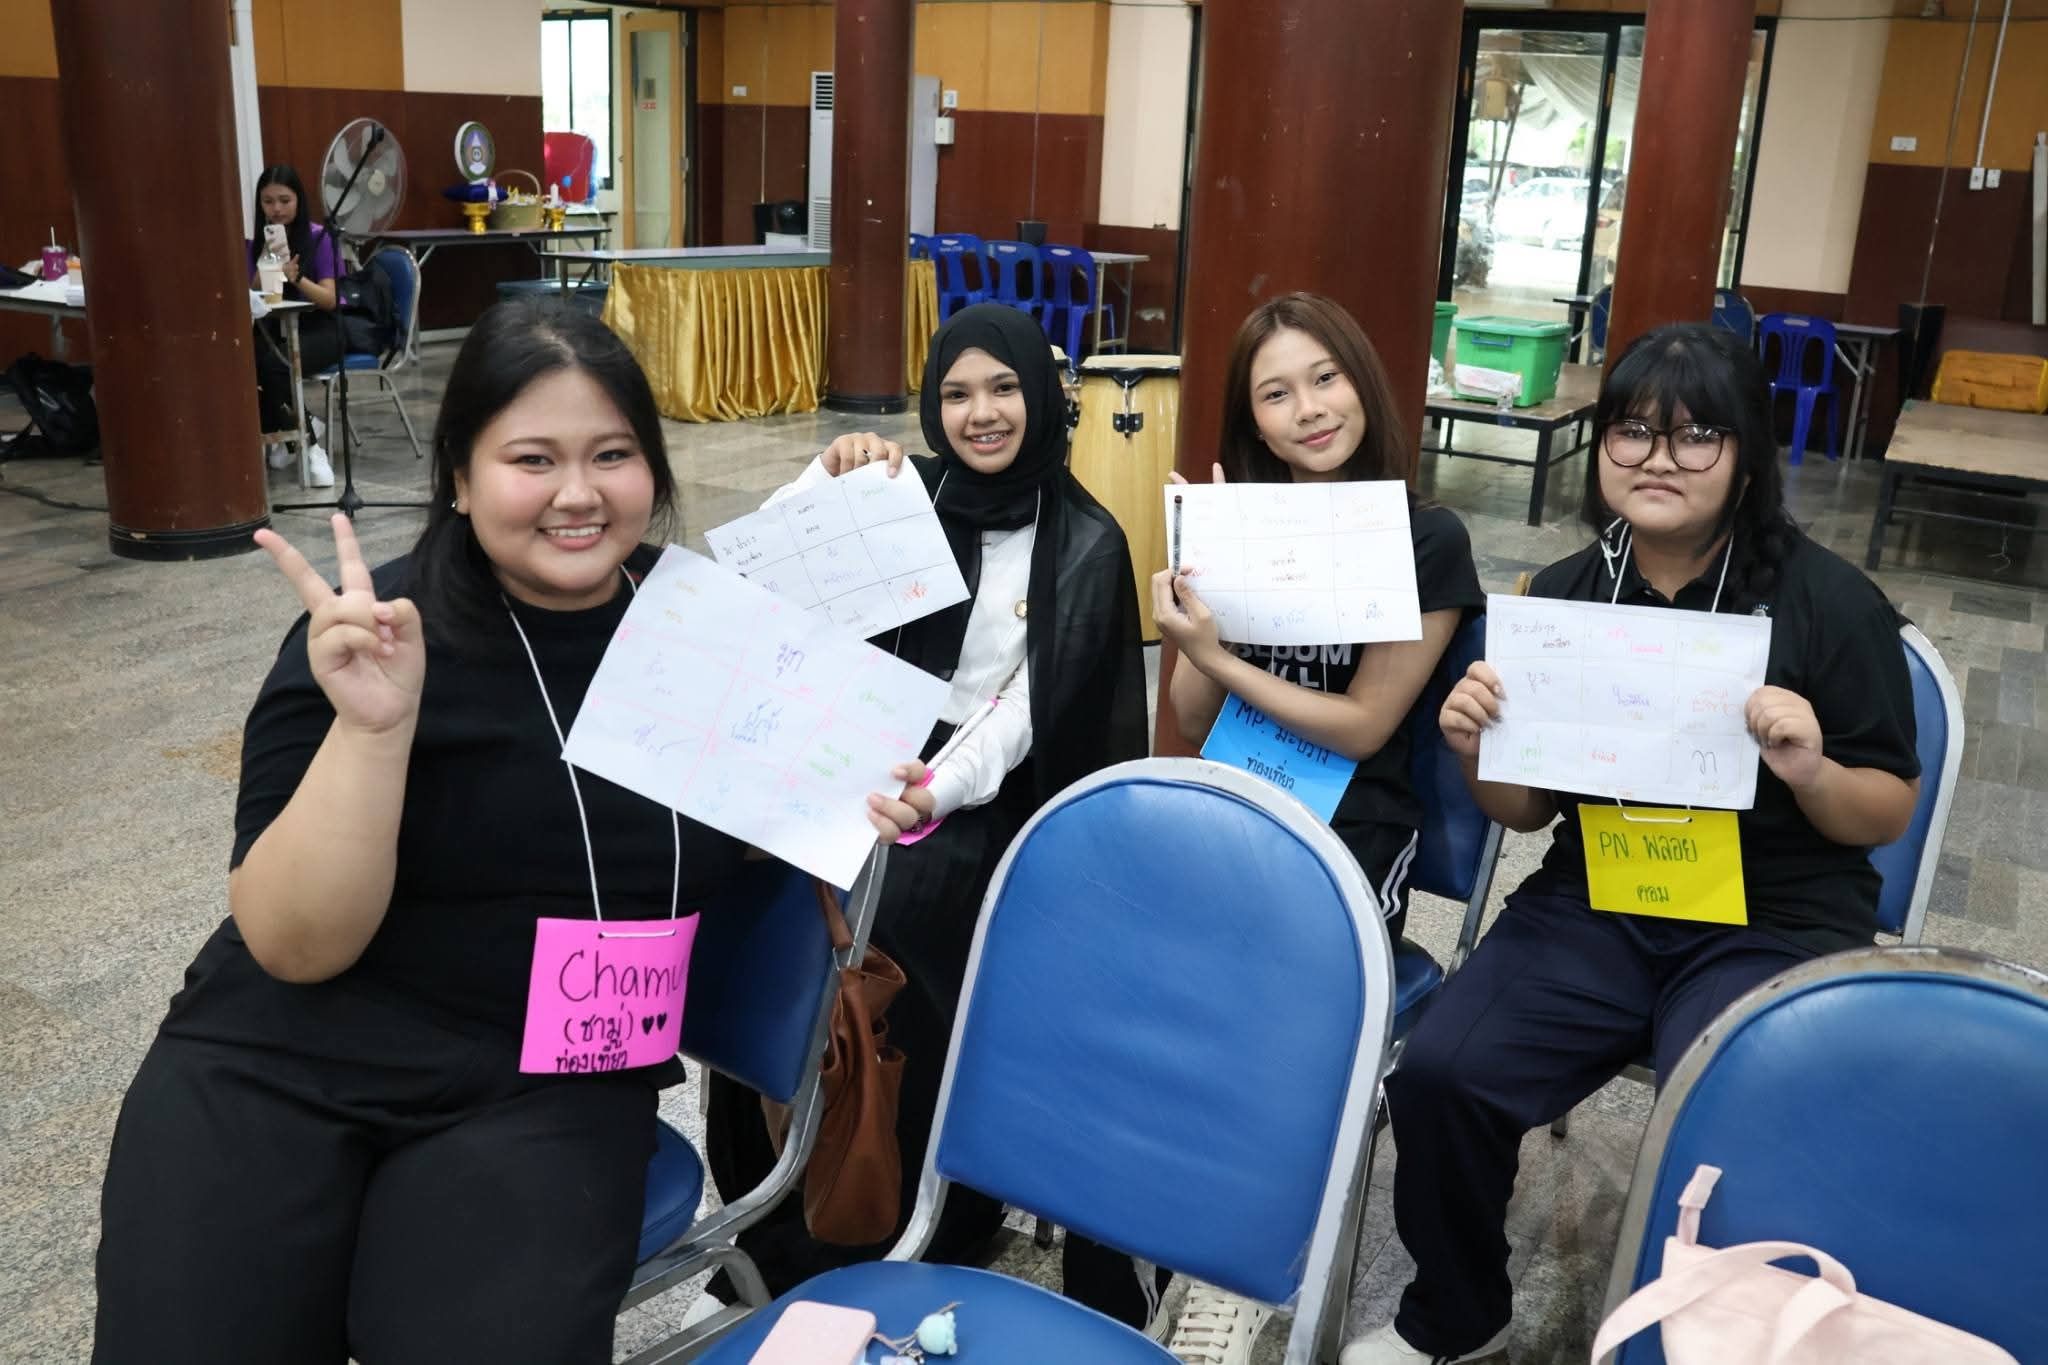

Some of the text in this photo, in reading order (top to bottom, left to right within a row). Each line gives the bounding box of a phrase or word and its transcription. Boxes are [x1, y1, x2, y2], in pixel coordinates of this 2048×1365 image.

[1247, 752, 1296, 790] ท่องเที่ยว
[1642, 832, 1698, 862] พลอย
